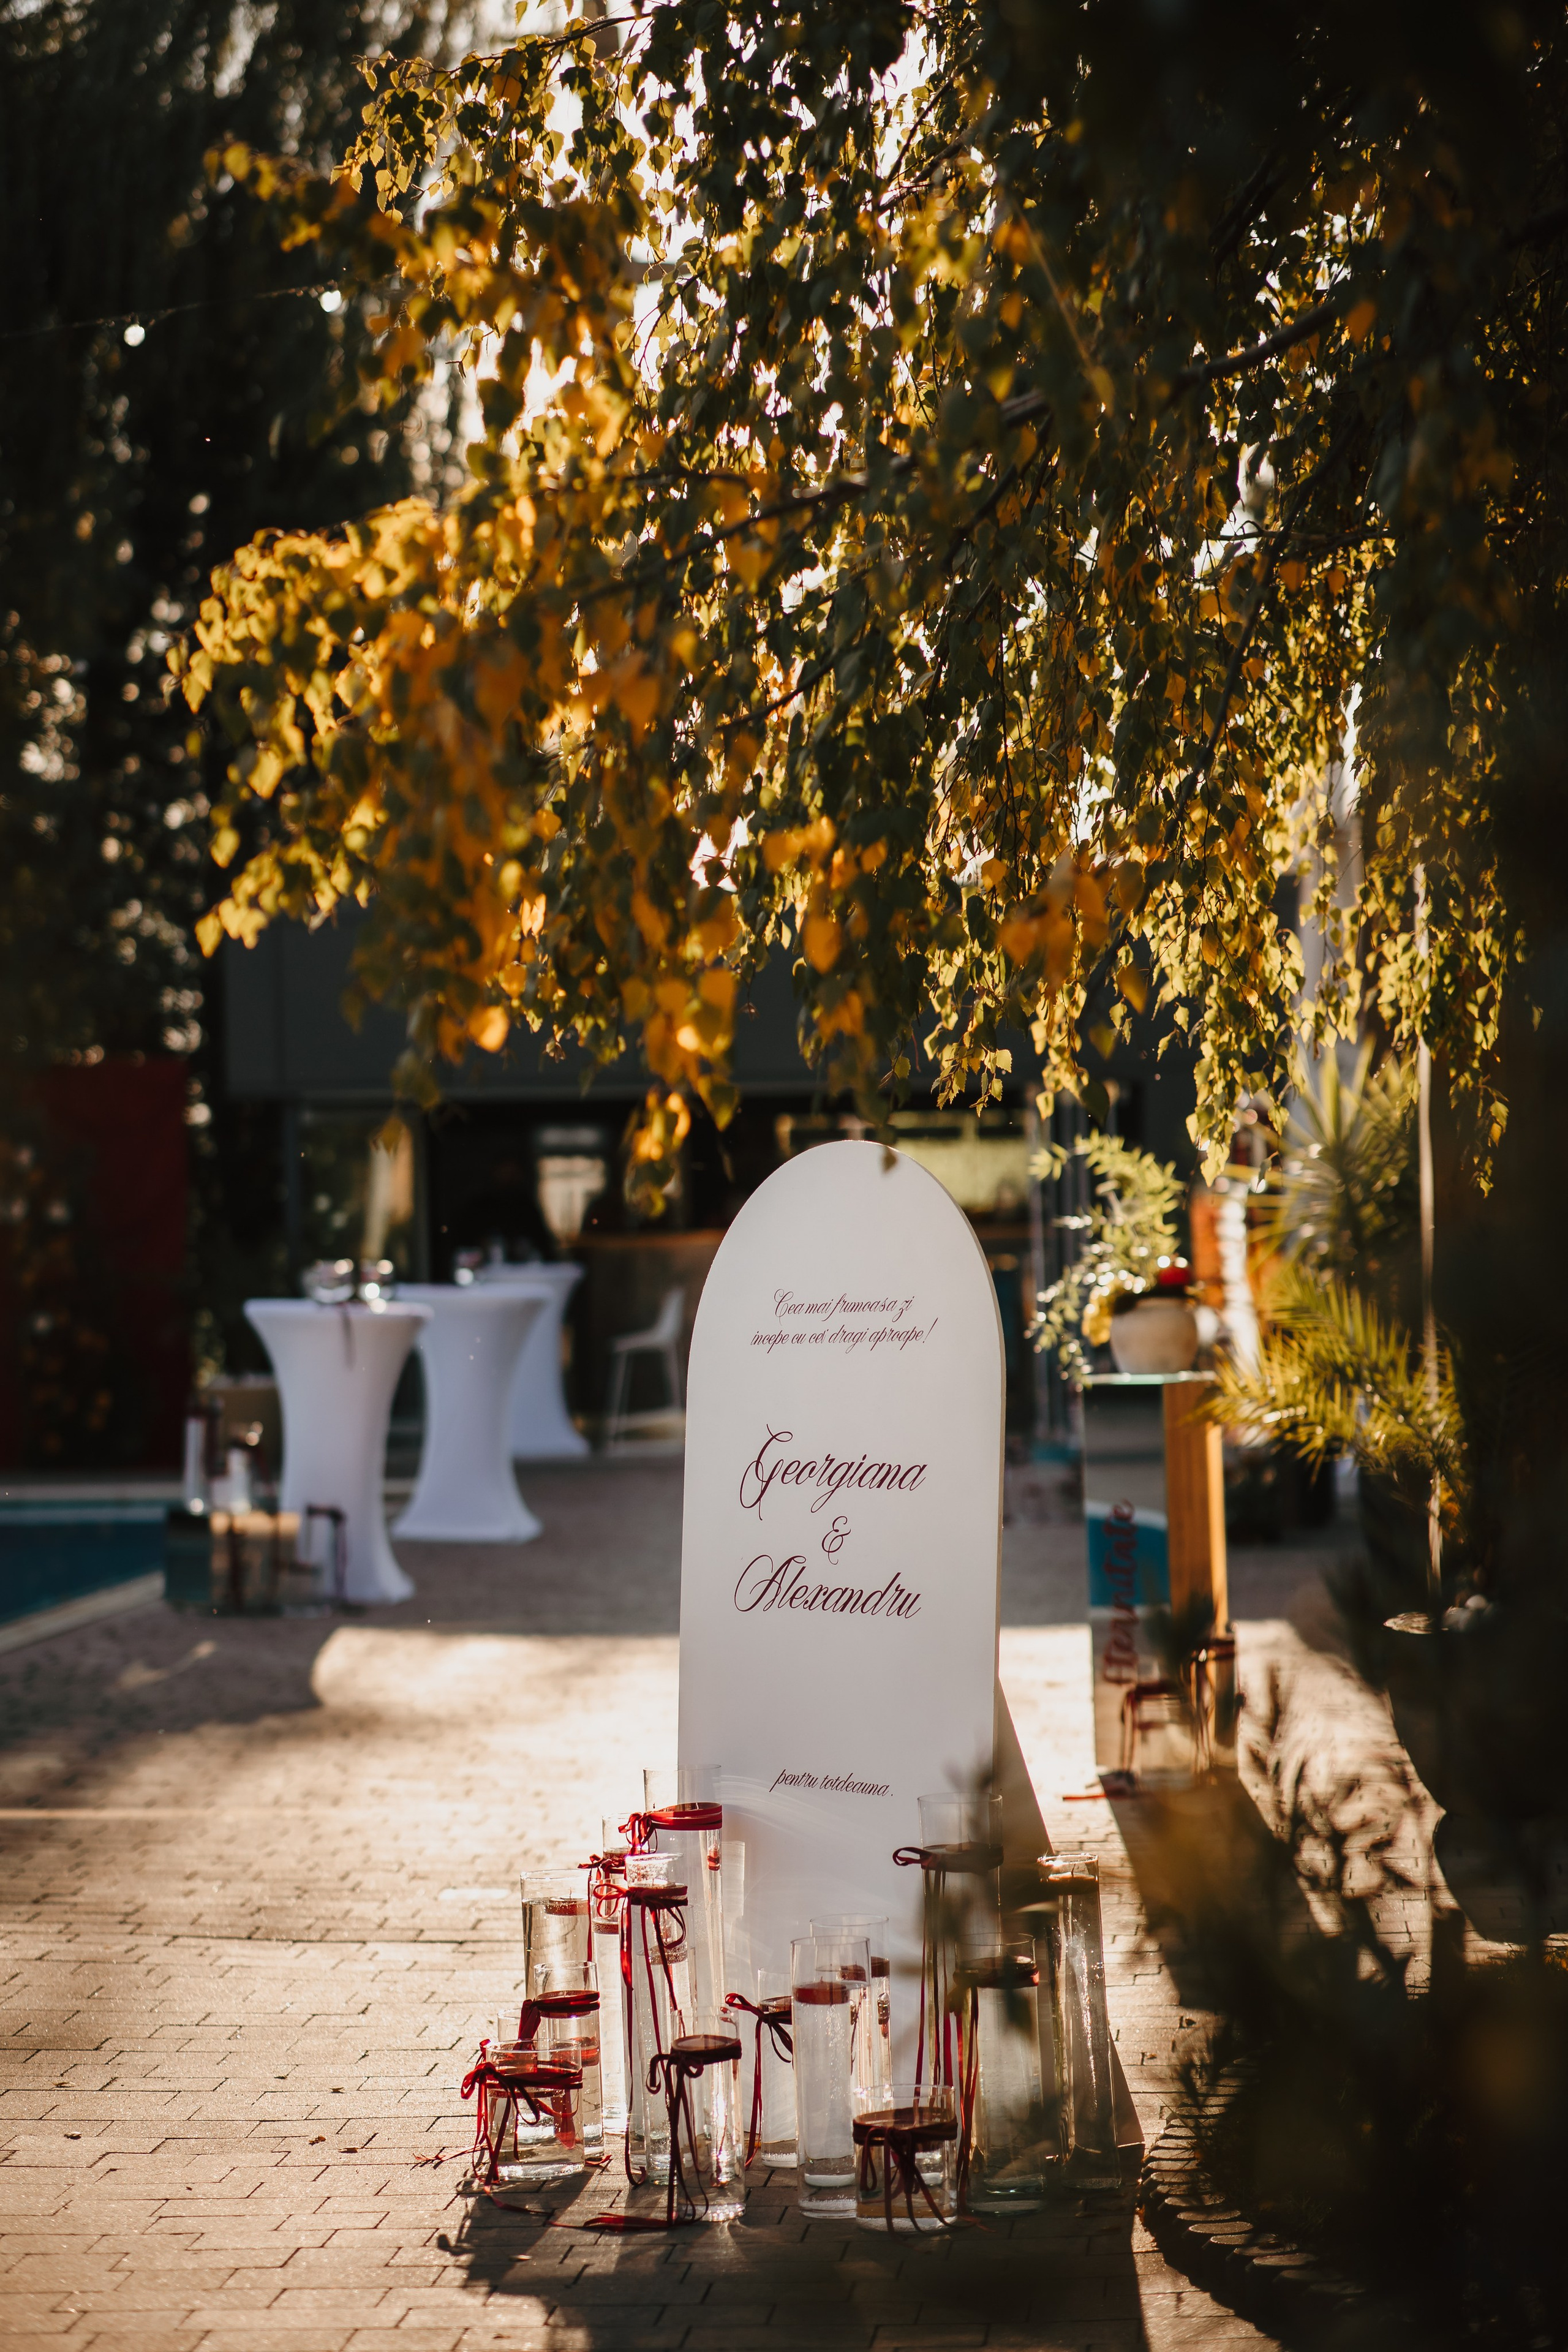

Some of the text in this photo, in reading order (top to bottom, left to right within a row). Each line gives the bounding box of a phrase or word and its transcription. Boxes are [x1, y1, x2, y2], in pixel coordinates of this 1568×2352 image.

[774, 1288, 915, 1325] Cea mai frumoasa zi
[750, 1330, 790, 1354] incepe
[791, 1333, 807, 1344] cu
[828, 1324, 869, 1354] dragi
[739, 1423, 928, 1521] Georgiana
[821, 1515, 851, 1566] &
[734, 1554, 922, 1619] Alexandru
[769, 1768, 819, 1793] pentru
